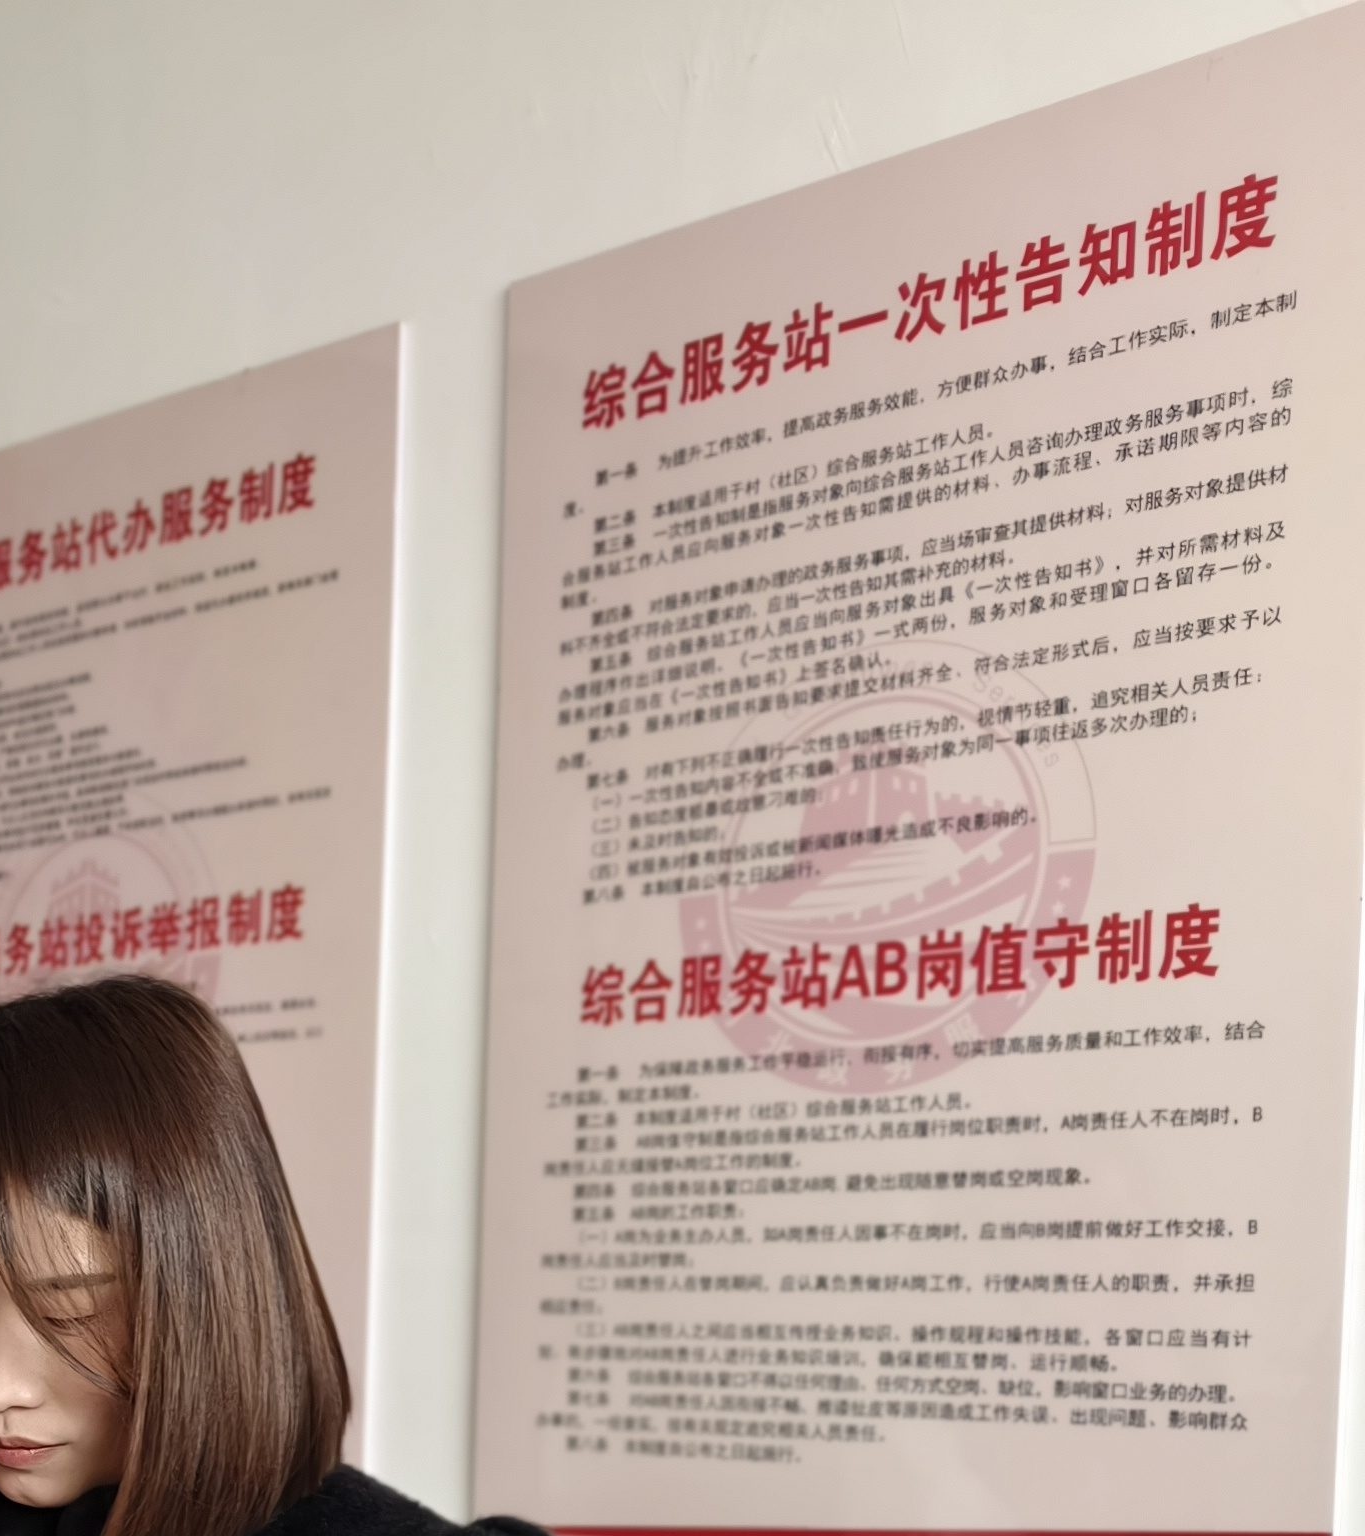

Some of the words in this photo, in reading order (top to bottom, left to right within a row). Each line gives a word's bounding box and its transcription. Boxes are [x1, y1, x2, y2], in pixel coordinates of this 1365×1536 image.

[582, 173, 1279, 430] 综合服务站一次性告知制度
[580, 903, 1221, 1027] 综合服务站AB岗值守制度
